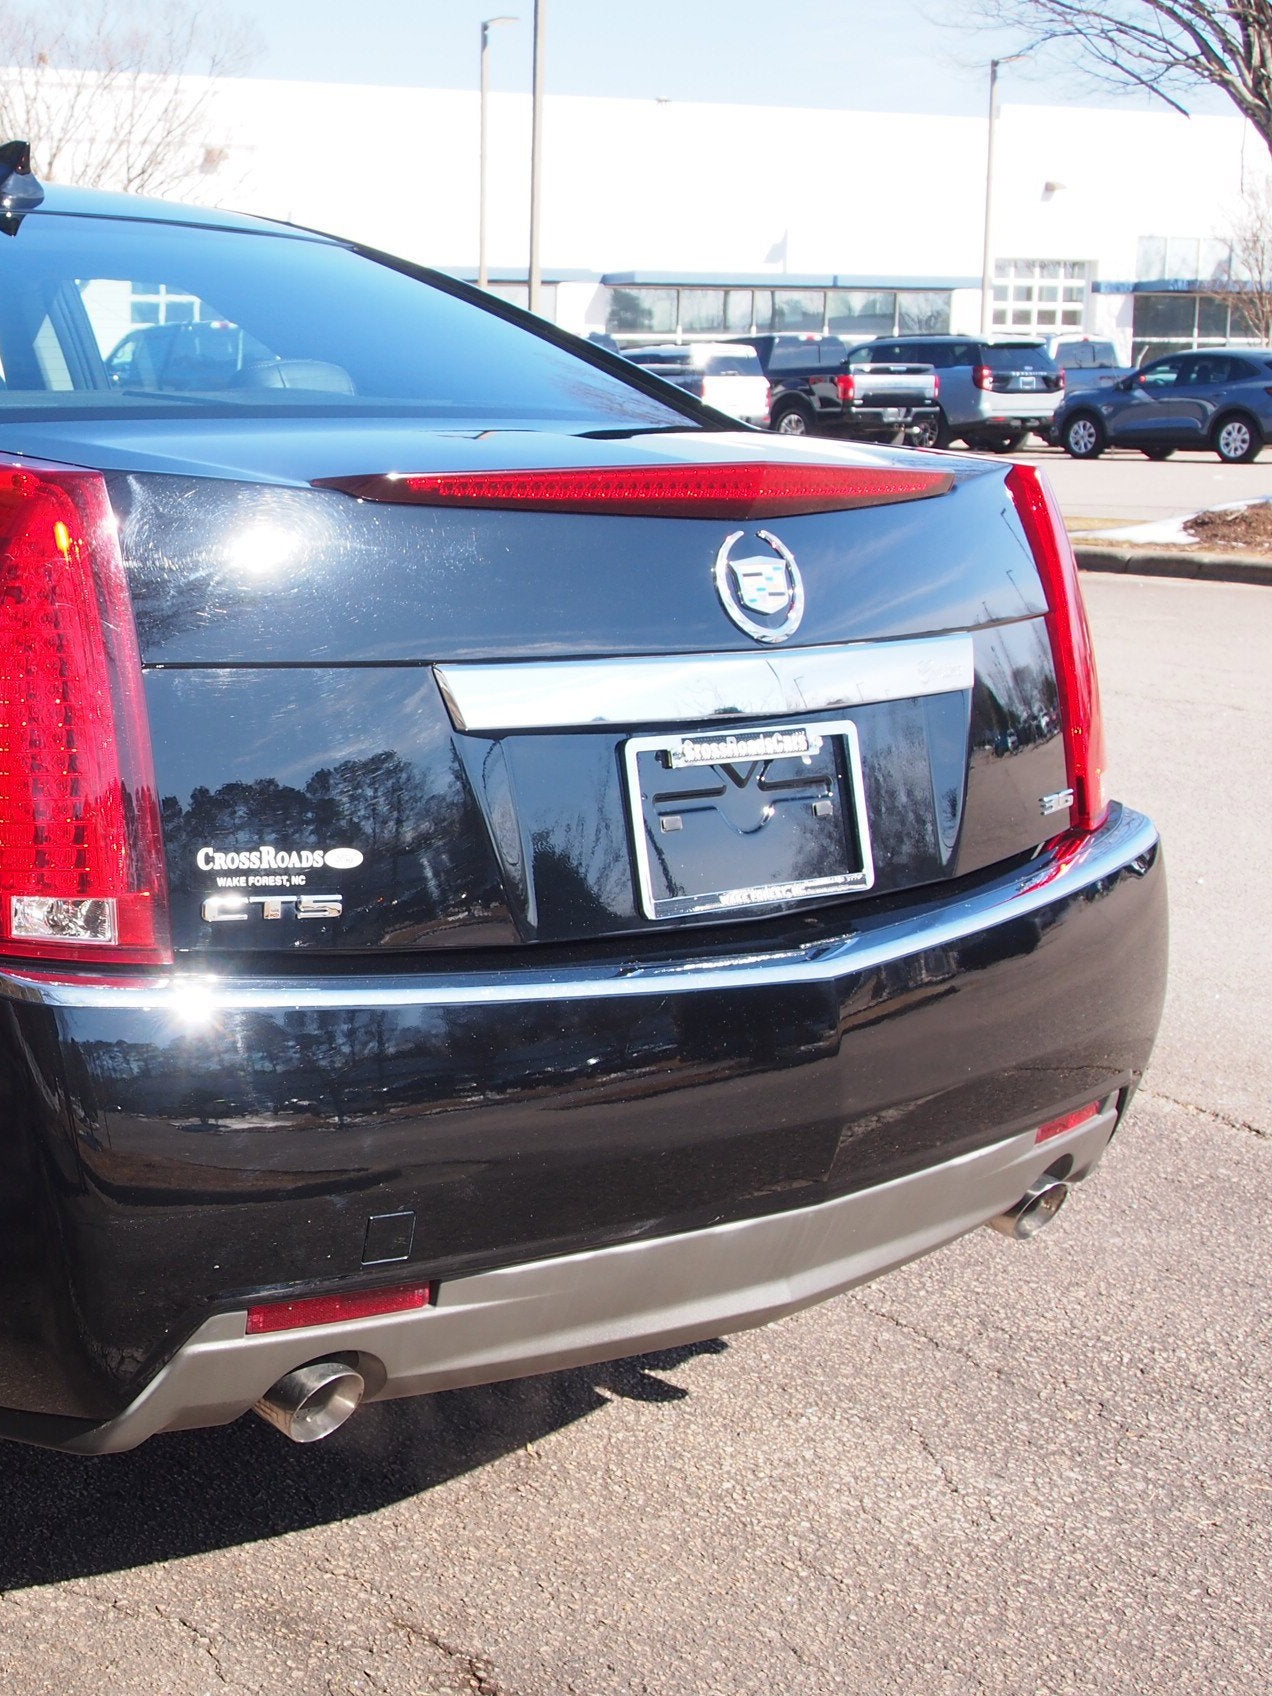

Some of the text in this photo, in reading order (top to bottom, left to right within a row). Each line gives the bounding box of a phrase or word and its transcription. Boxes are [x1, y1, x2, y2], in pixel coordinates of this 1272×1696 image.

[216, 875, 306, 887] WAKE FOREST, NC
[201, 894, 343, 922] CTS
